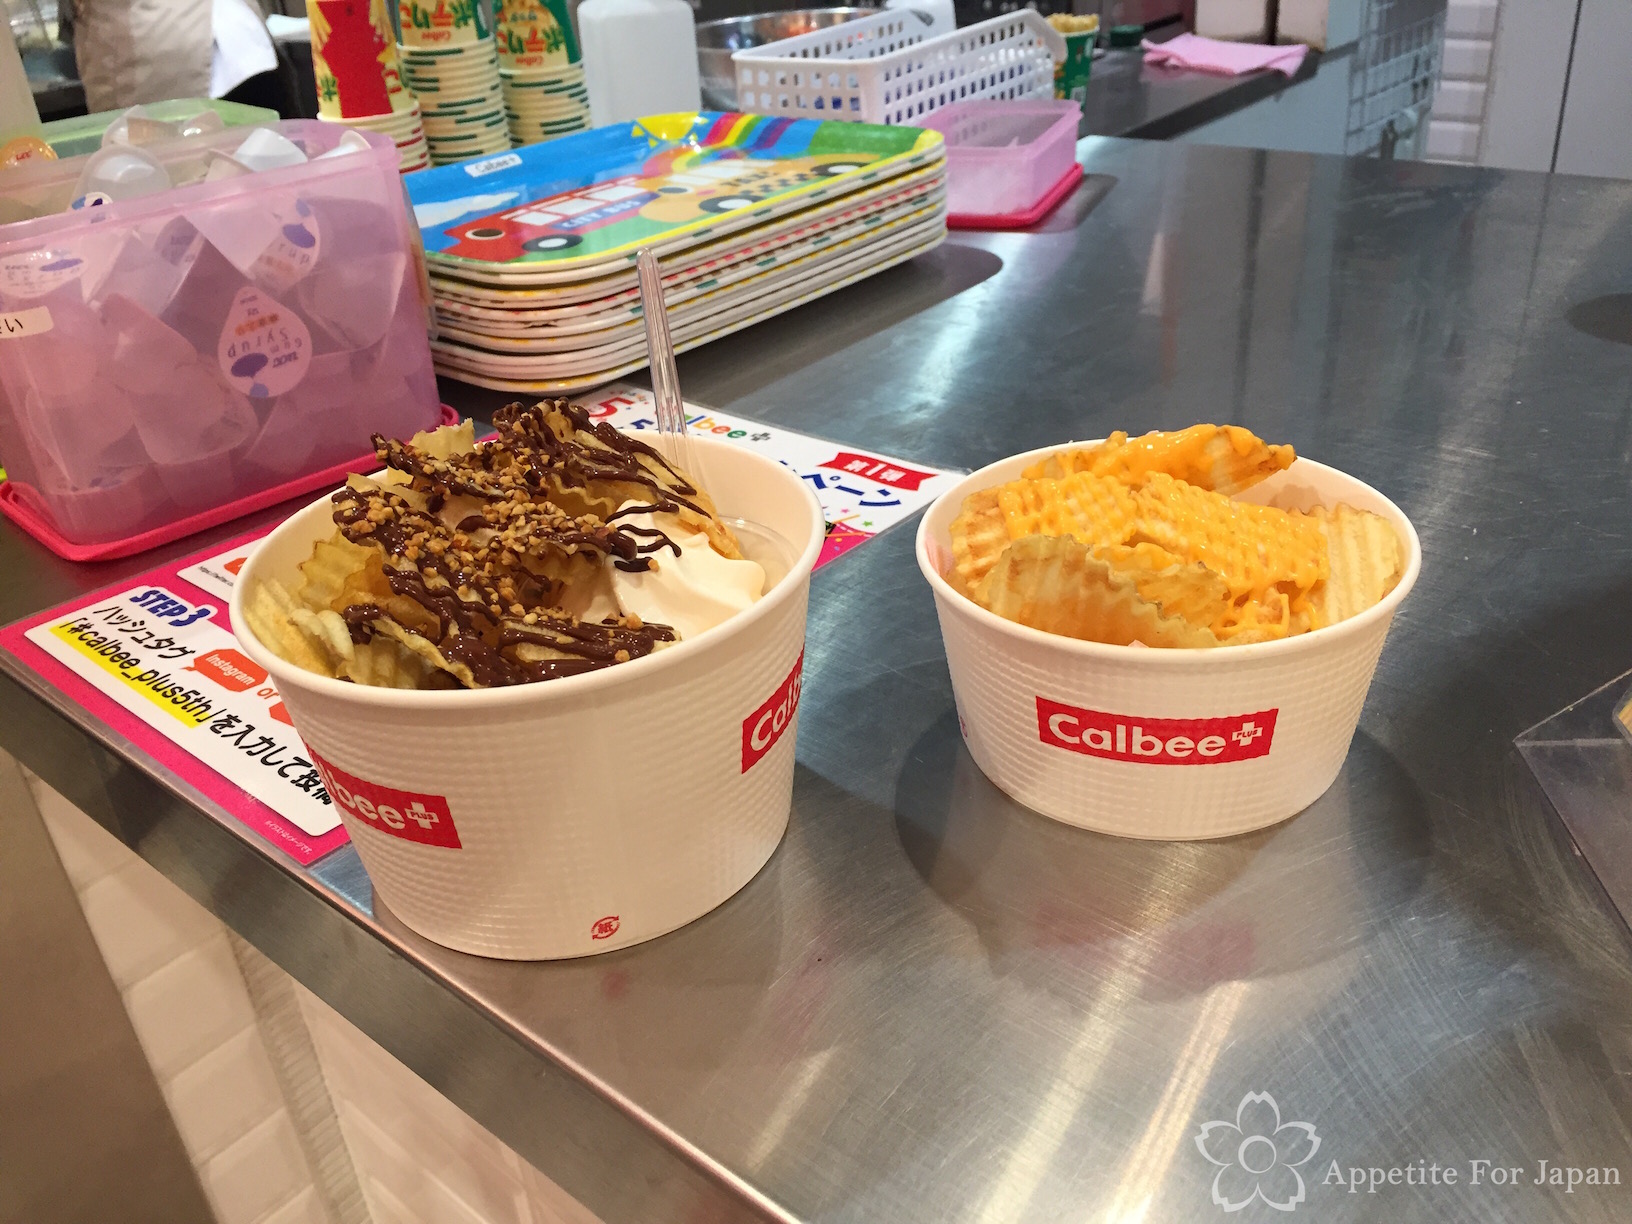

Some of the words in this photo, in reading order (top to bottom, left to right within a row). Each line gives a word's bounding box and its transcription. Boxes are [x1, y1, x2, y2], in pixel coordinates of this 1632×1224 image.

[0, 317, 24, 334] い
[227, 327, 289, 358] Syrup
[92, 605, 197, 659] ハッシュタグ
[205, 653, 256, 686] Instagram
[256, 687, 281, 700] or
[1047, 712, 1227, 757] Calbee
